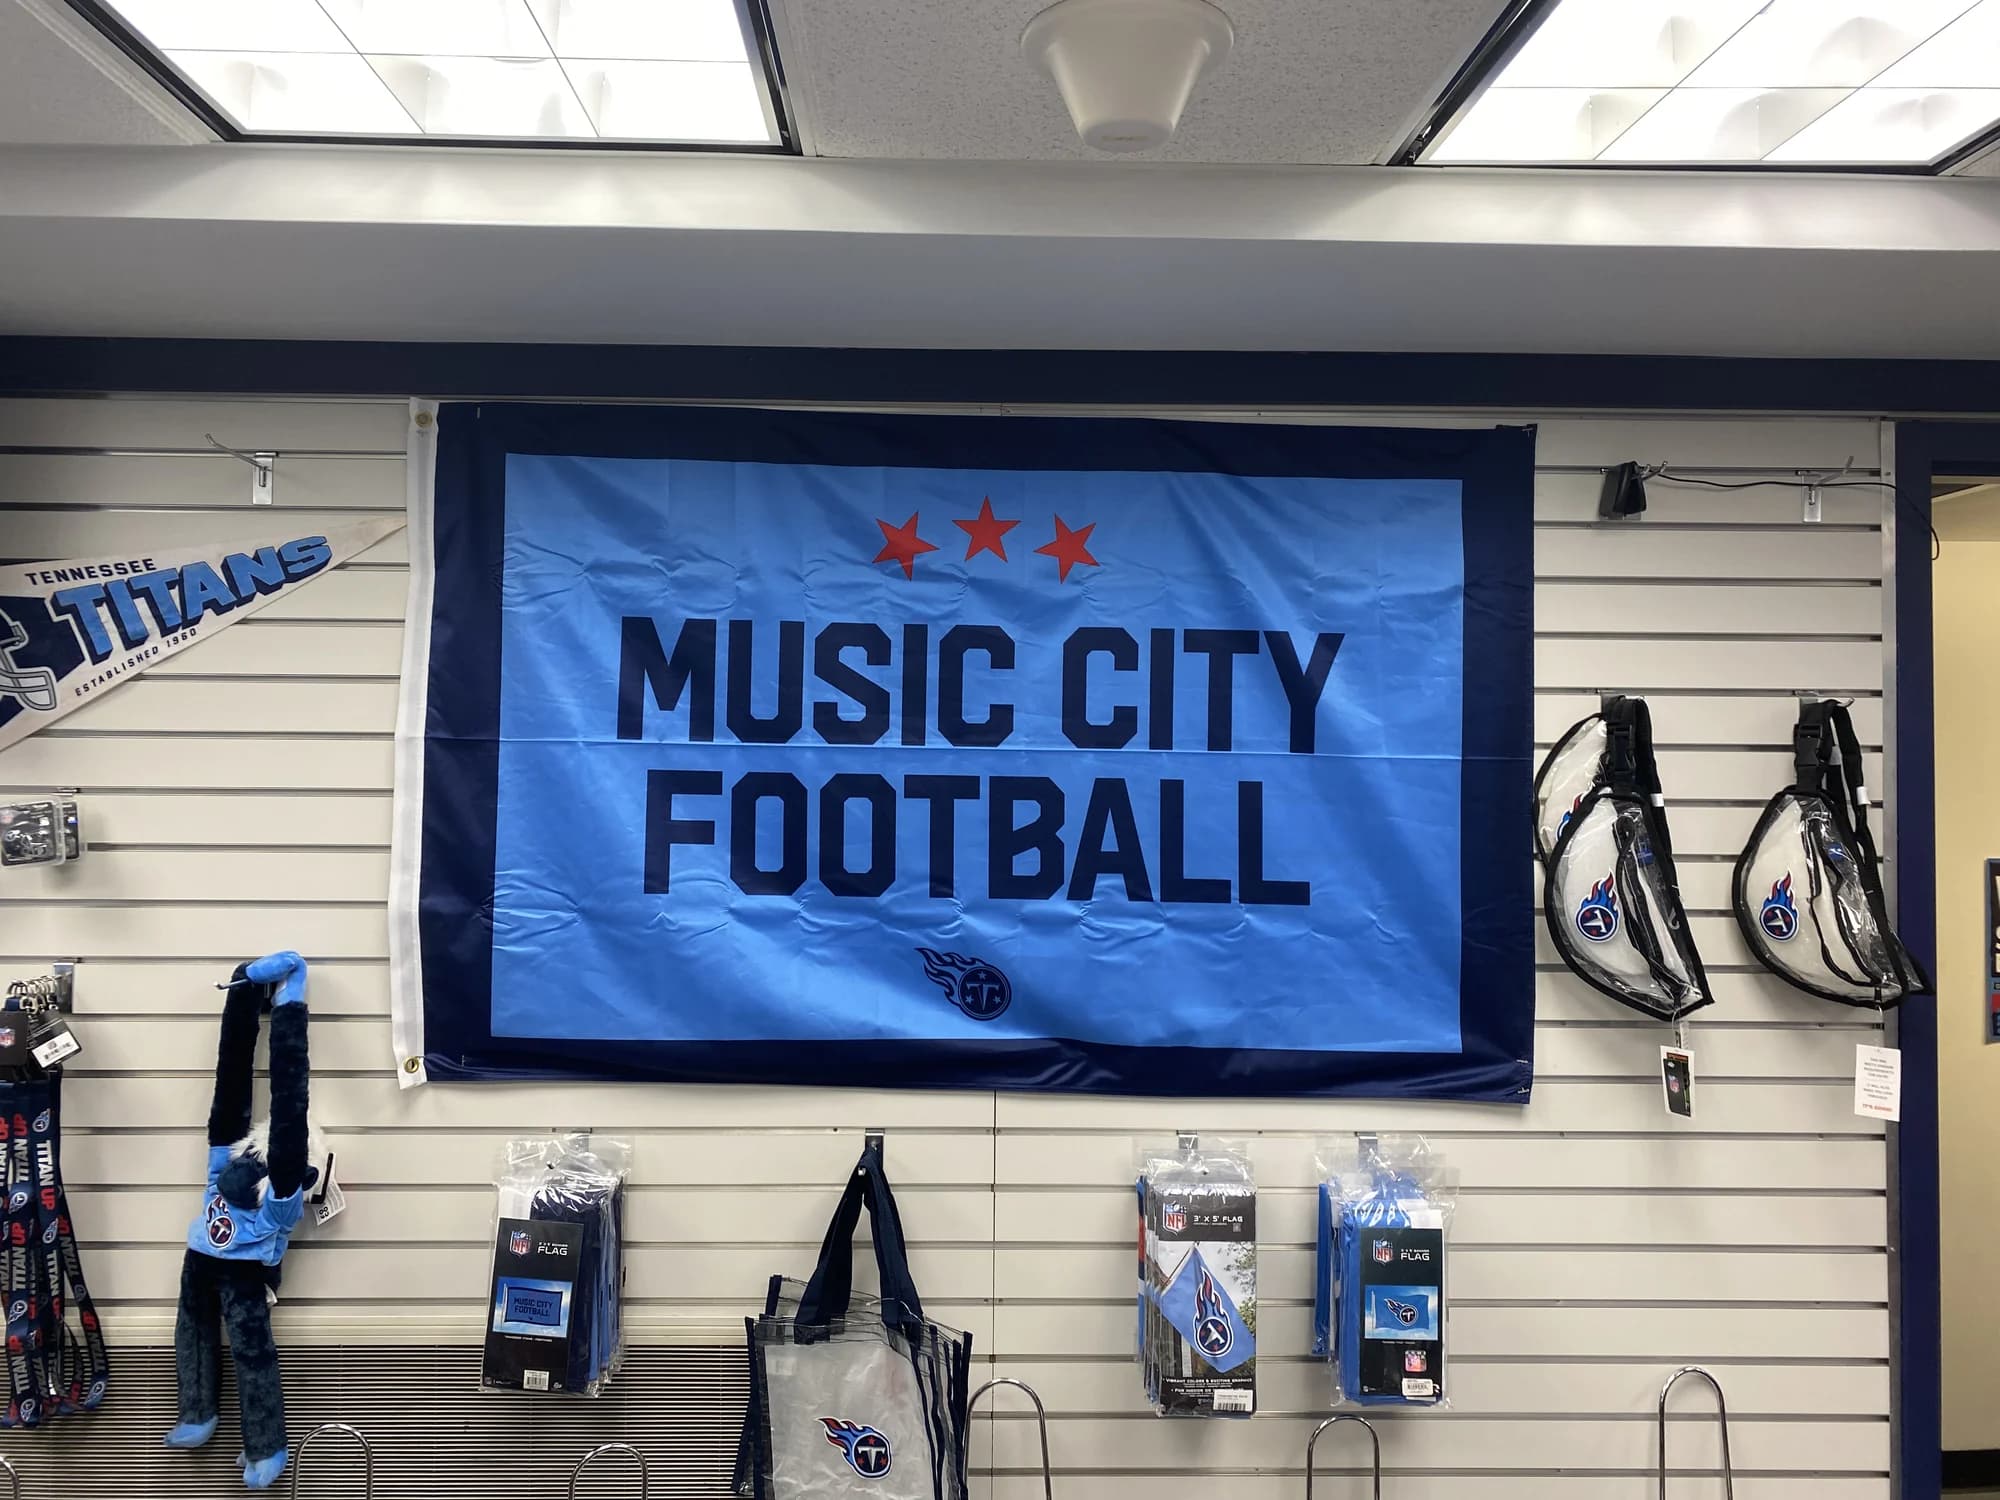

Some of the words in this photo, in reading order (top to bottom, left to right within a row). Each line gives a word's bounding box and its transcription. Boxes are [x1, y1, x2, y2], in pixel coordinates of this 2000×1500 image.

[24, 558, 157, 586] TENNESSEE
[49, 535, 333, 666] TITANS
[74, 645, 160, 697] ESTABLISHED
[165, 627, 198, 649] 1960
[616, 616, 1016, 748] MUSIC
[1061, 626, 1346, 754] CITY
[643, 769, 1311, 906] FOOTBALL
[13, 1138, 30, 1184] TITAN
[36, 1139, 55, 1187] TITAN
[40, 1187, 56, 1211] UP
[1222, 1215, 1244, 1223] FLAG
[11, 1222, 26, 1246] UP
[537, 1246, 568, 1256] FLAG
[12, 1246, 27, 1292] TITAN
[46, 1249, 59, 1297] TITAN
[1400, 1252, 1430, 1261] FLAG
[513, 1297, 536, 1307] MUSIC
[537, 1300, 553, 1310] CITY
[514, 1304, 550, 1317] FOOTBALL
[11, 1354, 31, 1395] TITAN
